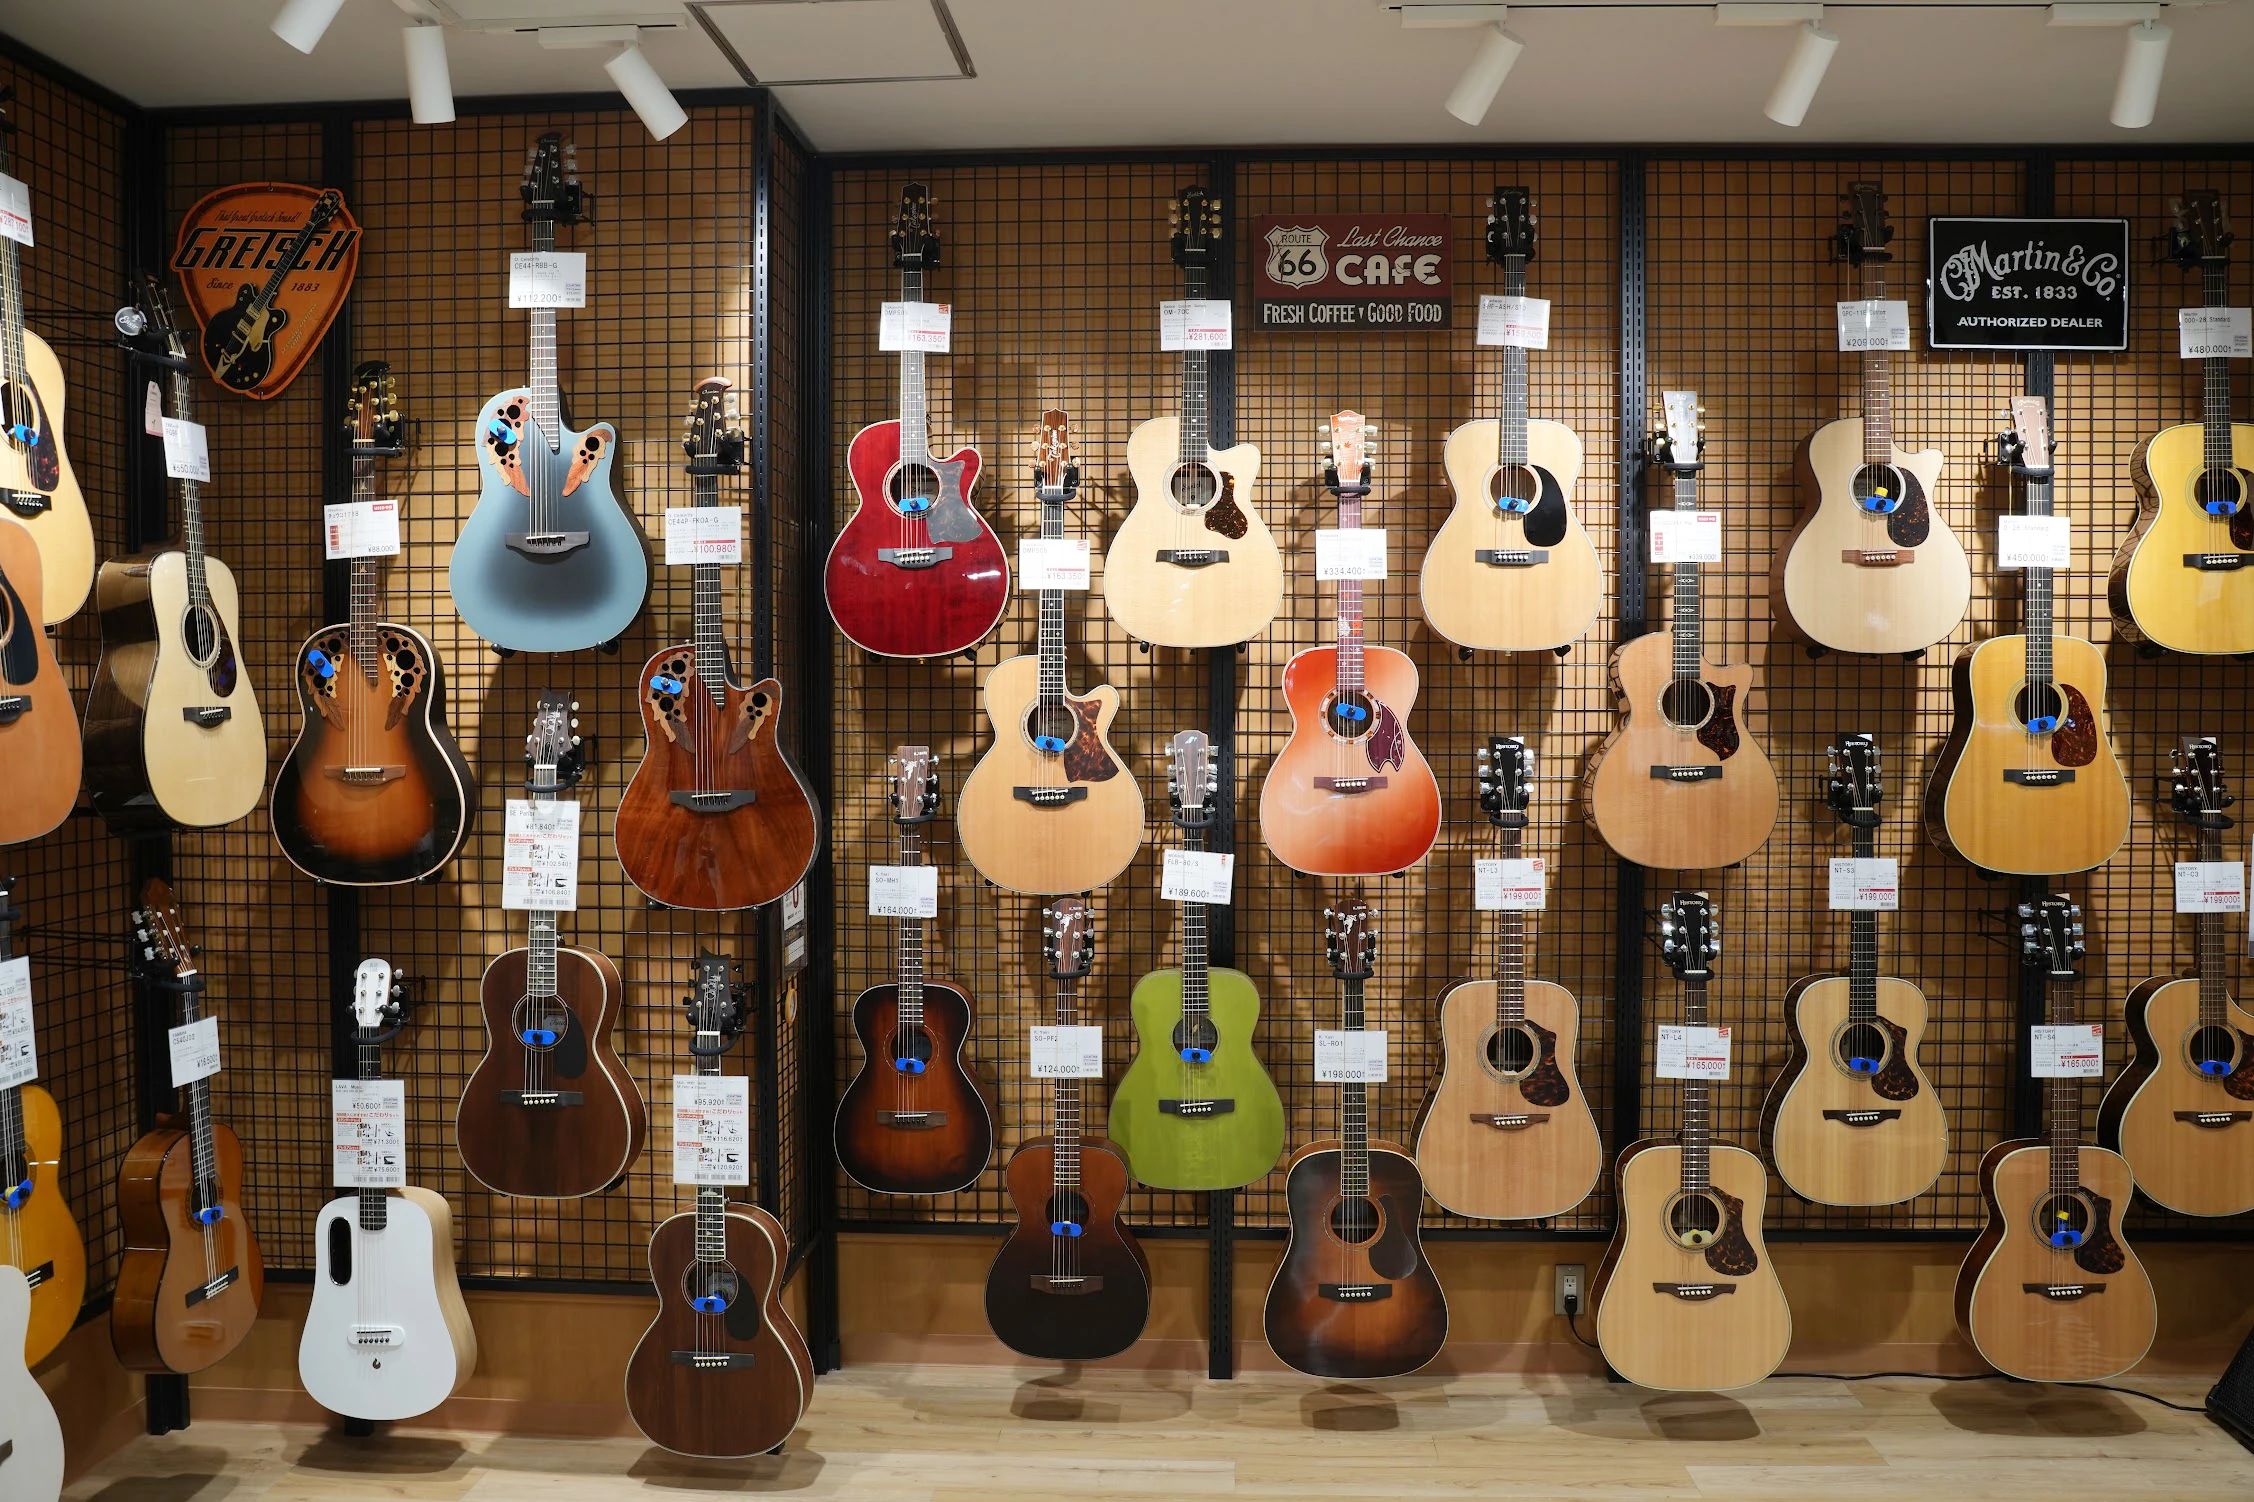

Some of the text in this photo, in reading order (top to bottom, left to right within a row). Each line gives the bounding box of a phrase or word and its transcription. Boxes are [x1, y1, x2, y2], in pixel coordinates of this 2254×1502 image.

[1281, 234, 1312, 244] ROUTE
[1337, 225, 1443, 247] Last Chance
[174, 227, 358, 271] GRETSCH
[1279, 249, 1317, 276] 66
[1335, 254, 1442, 286] CAFE
[206, 277, 320, 292] Since 1883
[1991, 286, 2078, 299] EST. 1833
[1263, 302, 1442, 324] FRESH COFFEE GOOD FOOD
[1957, 316, 2103, 328] AUTHORIZED DEALER
[2188, 345, 2228, 354] ¥480,000
[1168, 887, 1206, 898] ¥189,600
[1503, 892, 1538, 900] ¥199,000
[1859, 893, 1893, 901] ¥199,000
[2203, 896, 2238, 904] ¥199,000
[877, 905, 914, 914] ¥164,000
[1686, 1061, 1722, 1070] ¥165,000
[2061, 1059, 2096, 1068] ¥165,000
[1038, 1065, 1077, 1073] ¥124,000
[1322, 1070, 1361, 1079] ¥198,000
